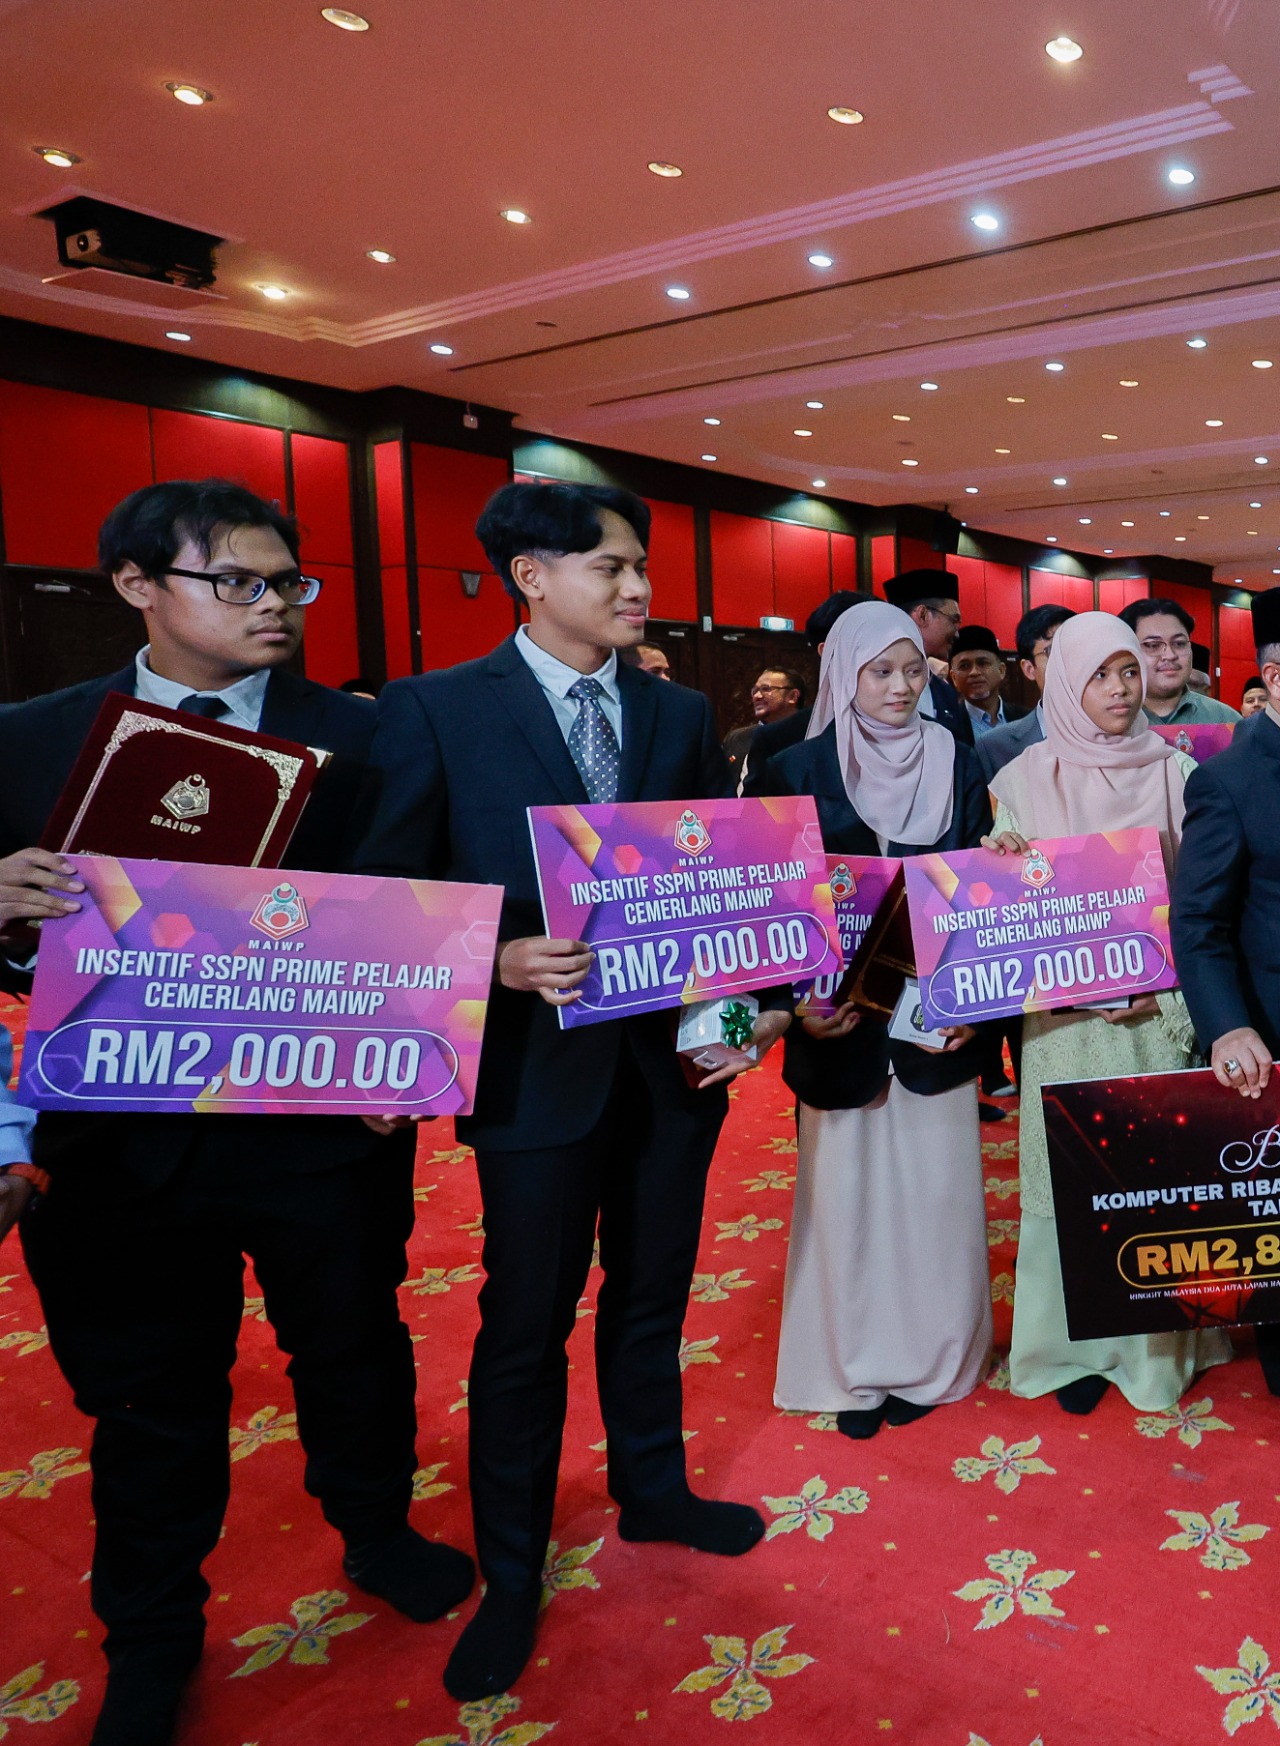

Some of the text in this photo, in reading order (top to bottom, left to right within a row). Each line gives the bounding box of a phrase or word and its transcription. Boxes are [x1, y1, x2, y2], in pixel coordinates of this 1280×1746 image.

[150, 815, 202, 834] MAIWP
[679, 855, 714, 866] MAIWP
[570, 861, 807, 905] INSENTIF SSPN PRIME PELAJAR
[1024, 887, 1057, 898] MAIWP
[624, 887, 774, 925] CEMERLANG MAIWP
[833, 902, 856, 910] IWP
[837, 913, 872, 931] PRIM
[933, 886, 1146, 934] INSENTIF SSPN PRIME PELAJAR
[248, 940, 305, 952] MAIWP
[976, 911, 1112, 949] CEMERLANG MAIWP
[76, 948, 452, 990] INSENTIF SSPN PRIME PELAJAR
[597, 919, 808, 997] RM2,000.00
[953, 938, 1145, 1006] RM2,000.00
[144, 981, 385, 1016] CEMERLANG MAIWP
[83, 1028, 421, 1094] RM2,000.00
[1092, 1181, 1225, 1212] KOMPUTER
[1164, 1288, 1202, 1298] MALAYSIA
[1203, 1285, 1220, 1293] DUA
[1221, 1283, 1242, 1292] JUTA
[1243, 1281, 1268, 1290] LAPAN
